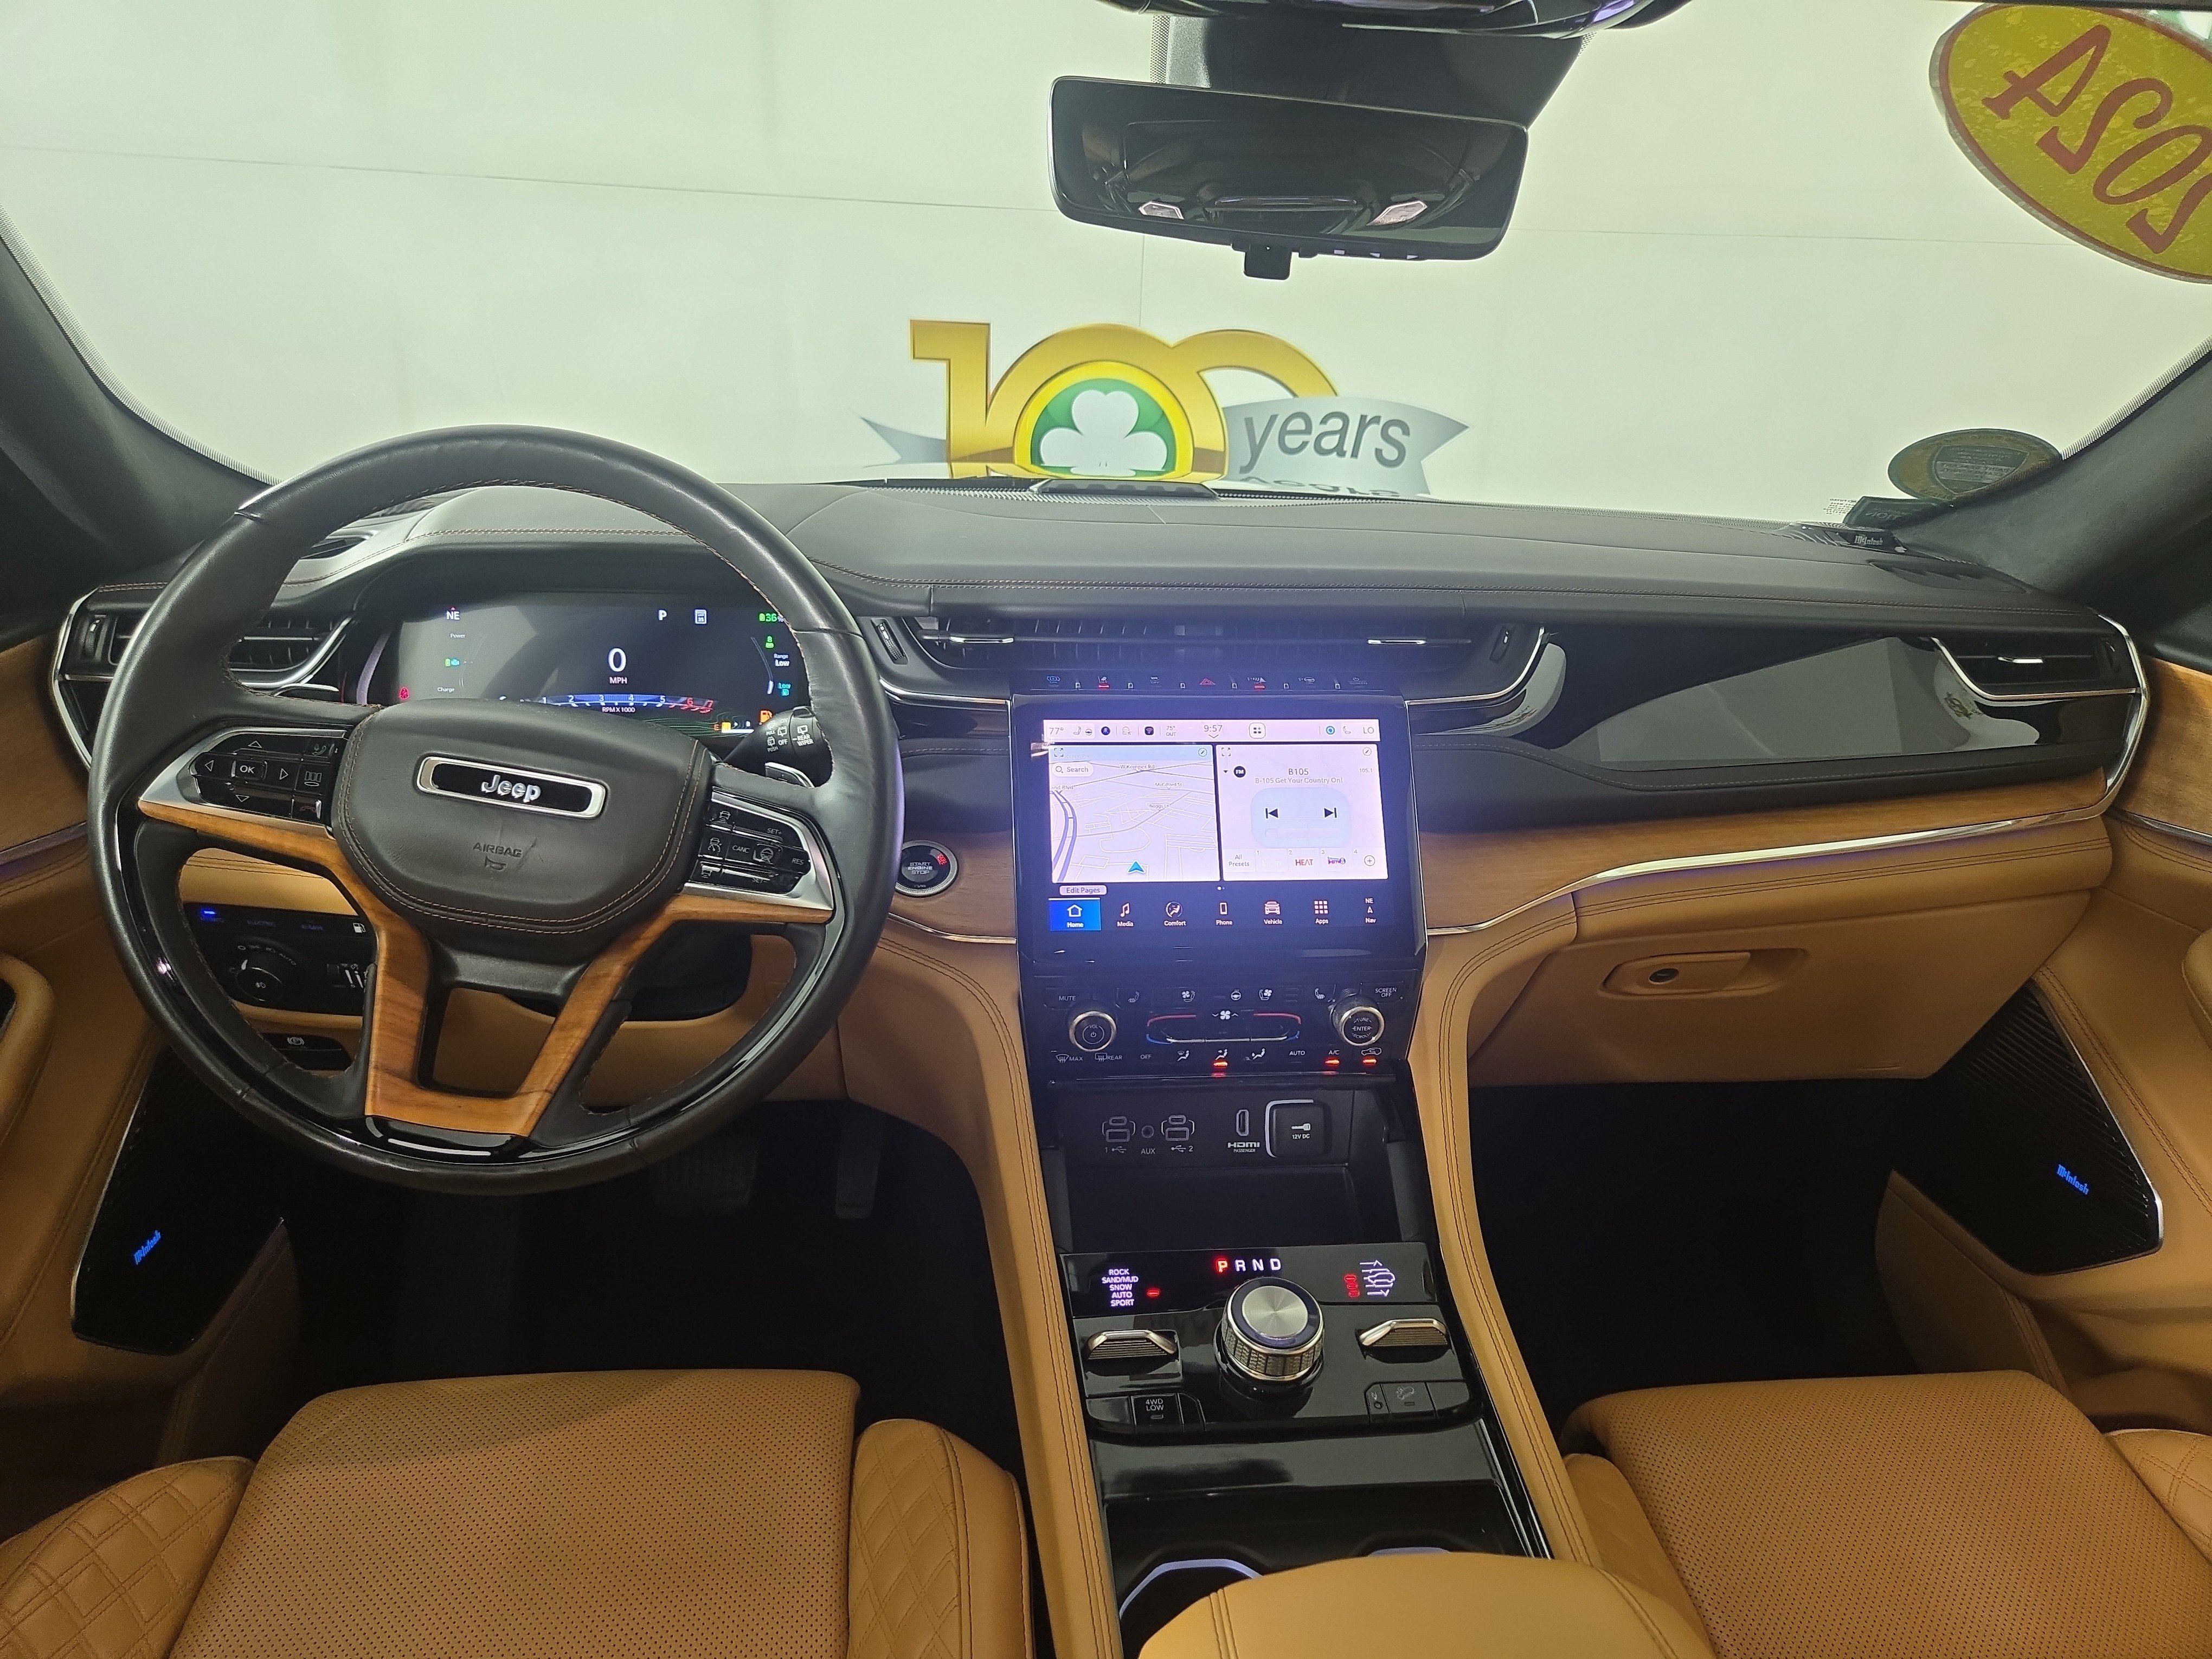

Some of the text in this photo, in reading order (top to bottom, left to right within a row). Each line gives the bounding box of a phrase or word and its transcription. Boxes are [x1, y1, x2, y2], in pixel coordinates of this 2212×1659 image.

[1242, 410, 1411, 474] years
[446, 610, 460, 620] NE
[658, 609, 667, 621] P
[608, 648, 626, 672] 0
[1049, 727, 1064, 735] 77°
[797, 738, 814, 747] WIPER
[240, 765, 255, 774] OK
[481, 774, 541, 802] Jeep
[473, 842, 523, 858] AIRBAG
[732, 845, 750, 853] CANC
[1218, 1258, 1281, 1272] P R N D
[1110, 1299, 1135, 1307] SPORT
